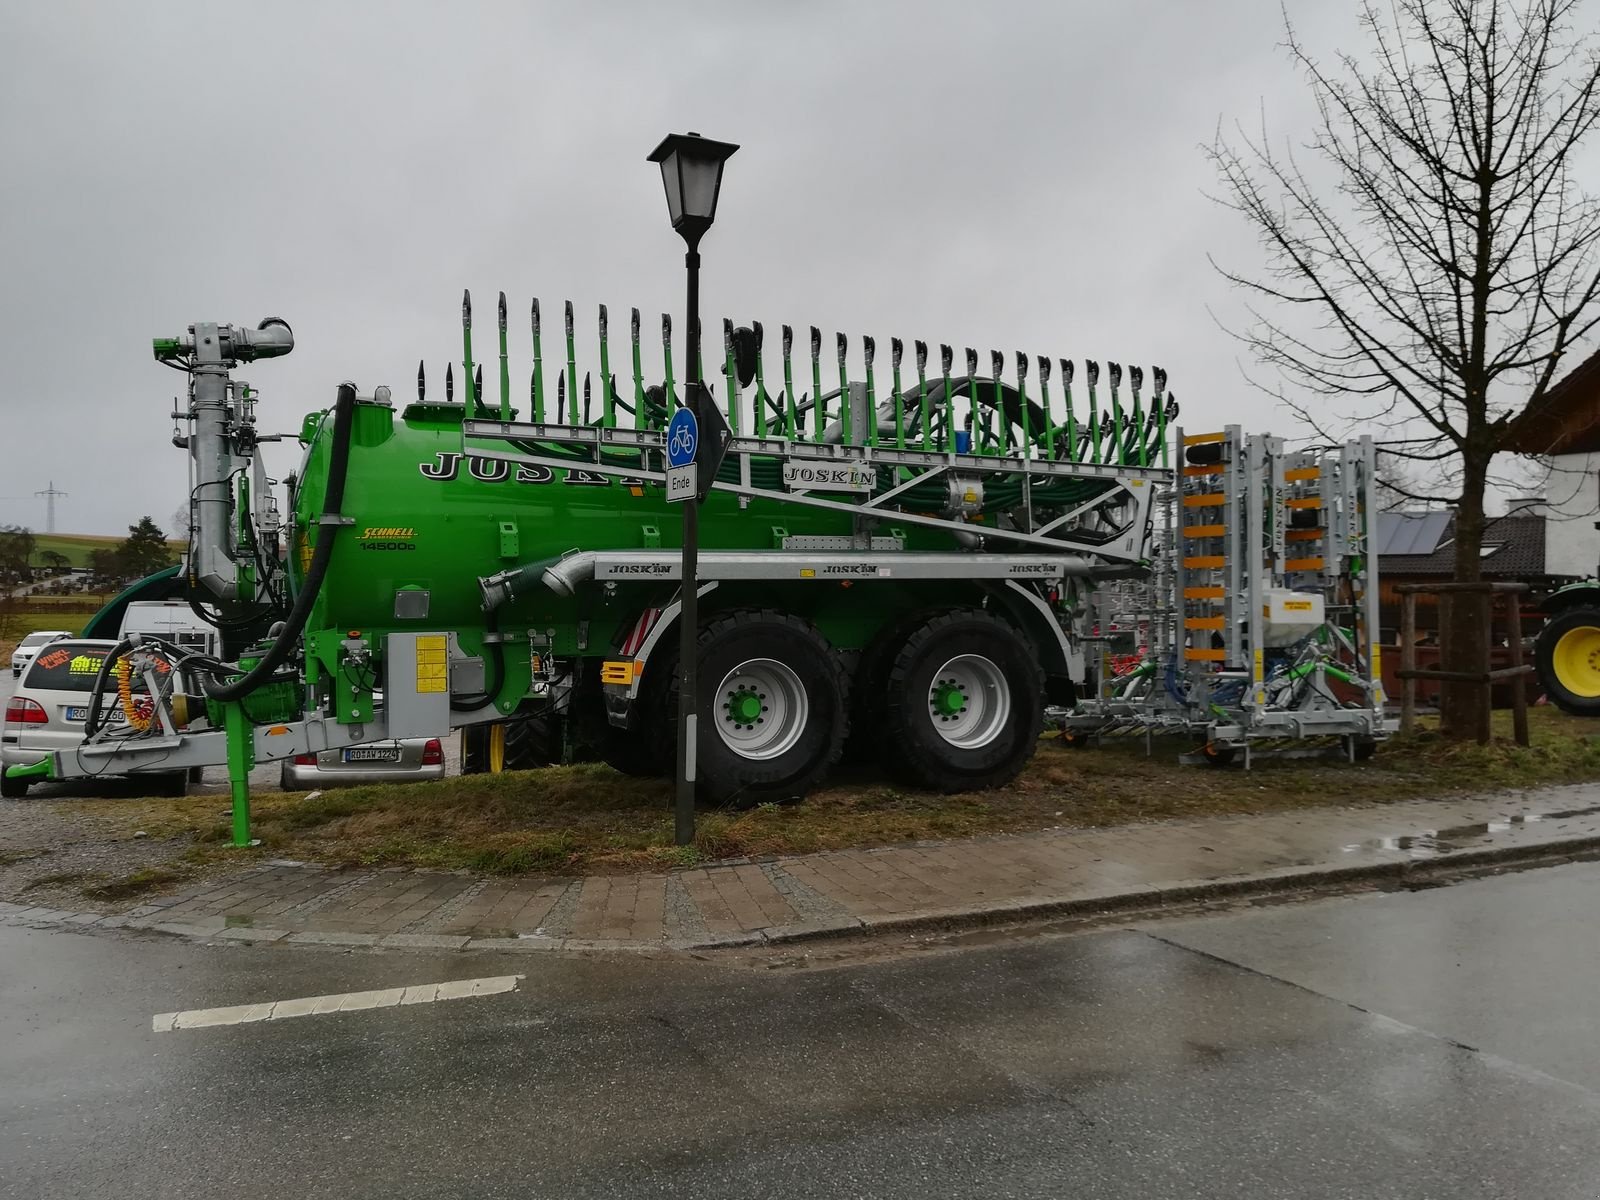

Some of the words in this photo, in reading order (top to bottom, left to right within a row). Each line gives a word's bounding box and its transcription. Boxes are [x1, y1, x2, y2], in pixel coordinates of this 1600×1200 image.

[672, 475, 690, 490] Ende
[784, 467, 877, 486] JOSKIN
[361, 527, 414, 539] SCHNELL
[72, 709, 86, 718] RO
[351, 750, 361, 759] RO
